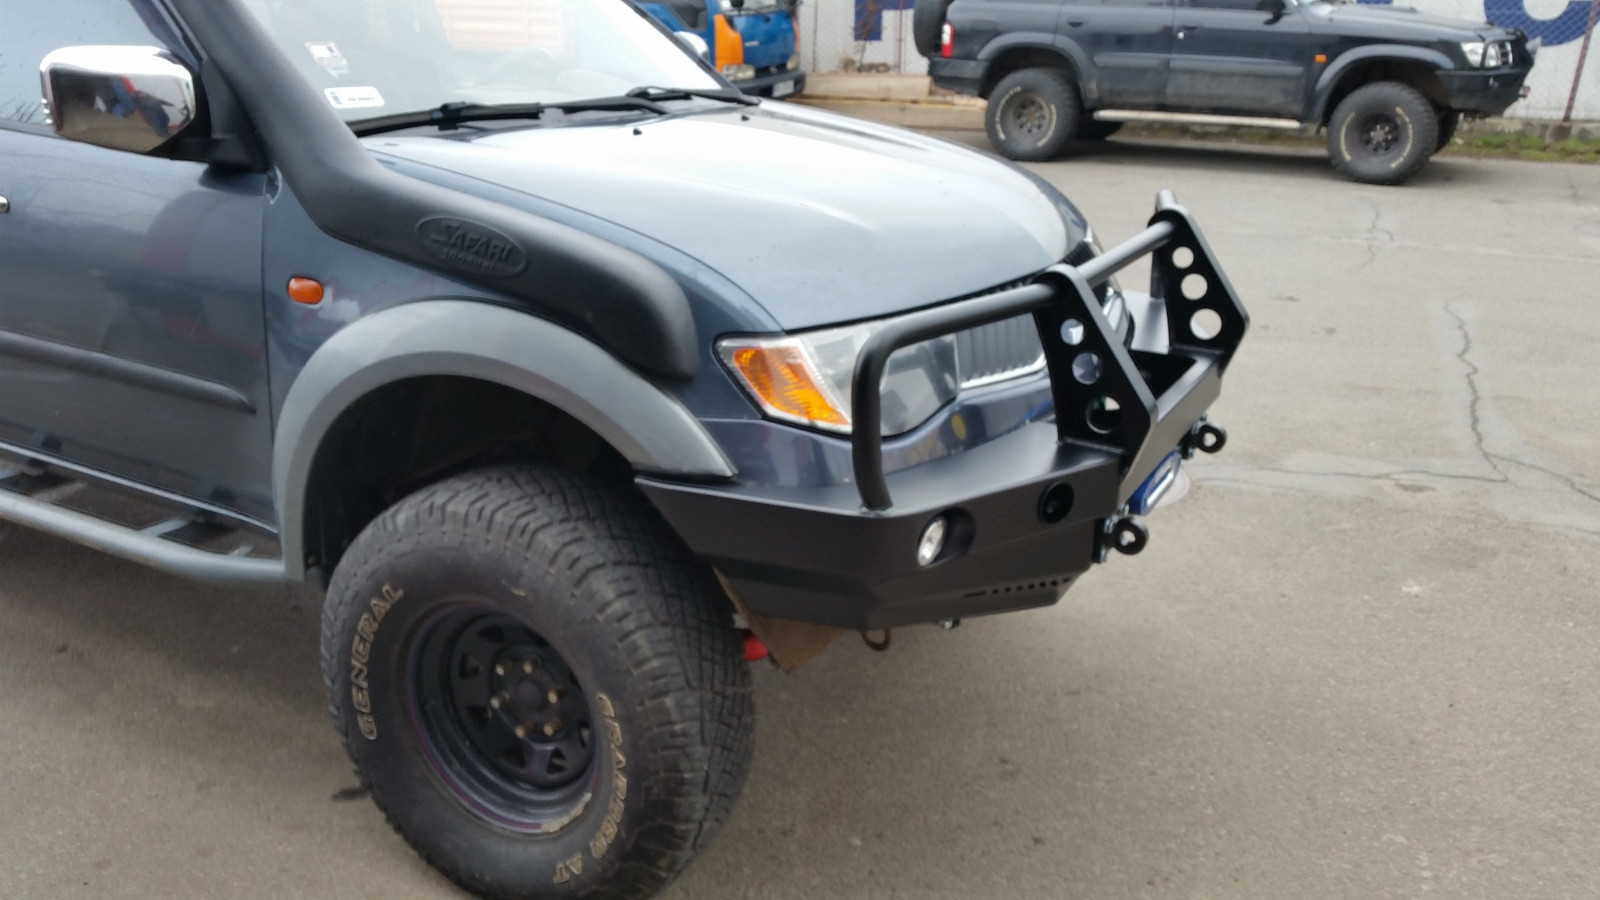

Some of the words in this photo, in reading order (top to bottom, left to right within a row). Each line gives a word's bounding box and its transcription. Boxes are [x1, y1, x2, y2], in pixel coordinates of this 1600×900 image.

[427, 219, 514, 263] SAFARI
[351, 582, 404, 740] GENERAL
[589, 692, 628, 859] GRABBER
[552, 852, 583, 883] AT
